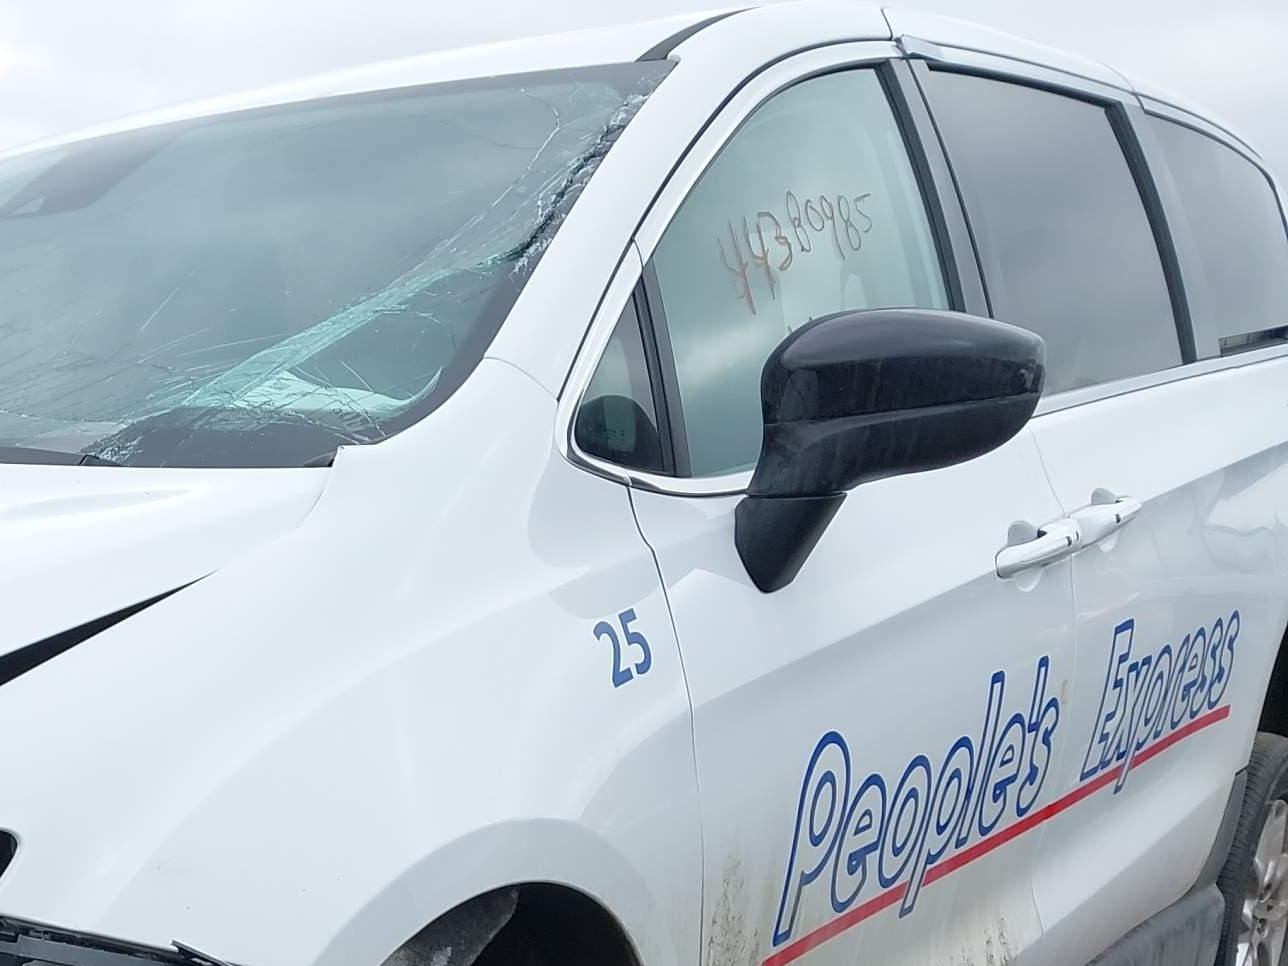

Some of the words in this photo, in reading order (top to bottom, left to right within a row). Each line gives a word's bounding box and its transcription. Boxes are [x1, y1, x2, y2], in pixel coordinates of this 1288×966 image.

[717, 190, 872, 315] 44380985
[592, 607, 652, 688] 25
[772, 655, 1060, 947] People's
[1079, 609, 1241, 795] Express
